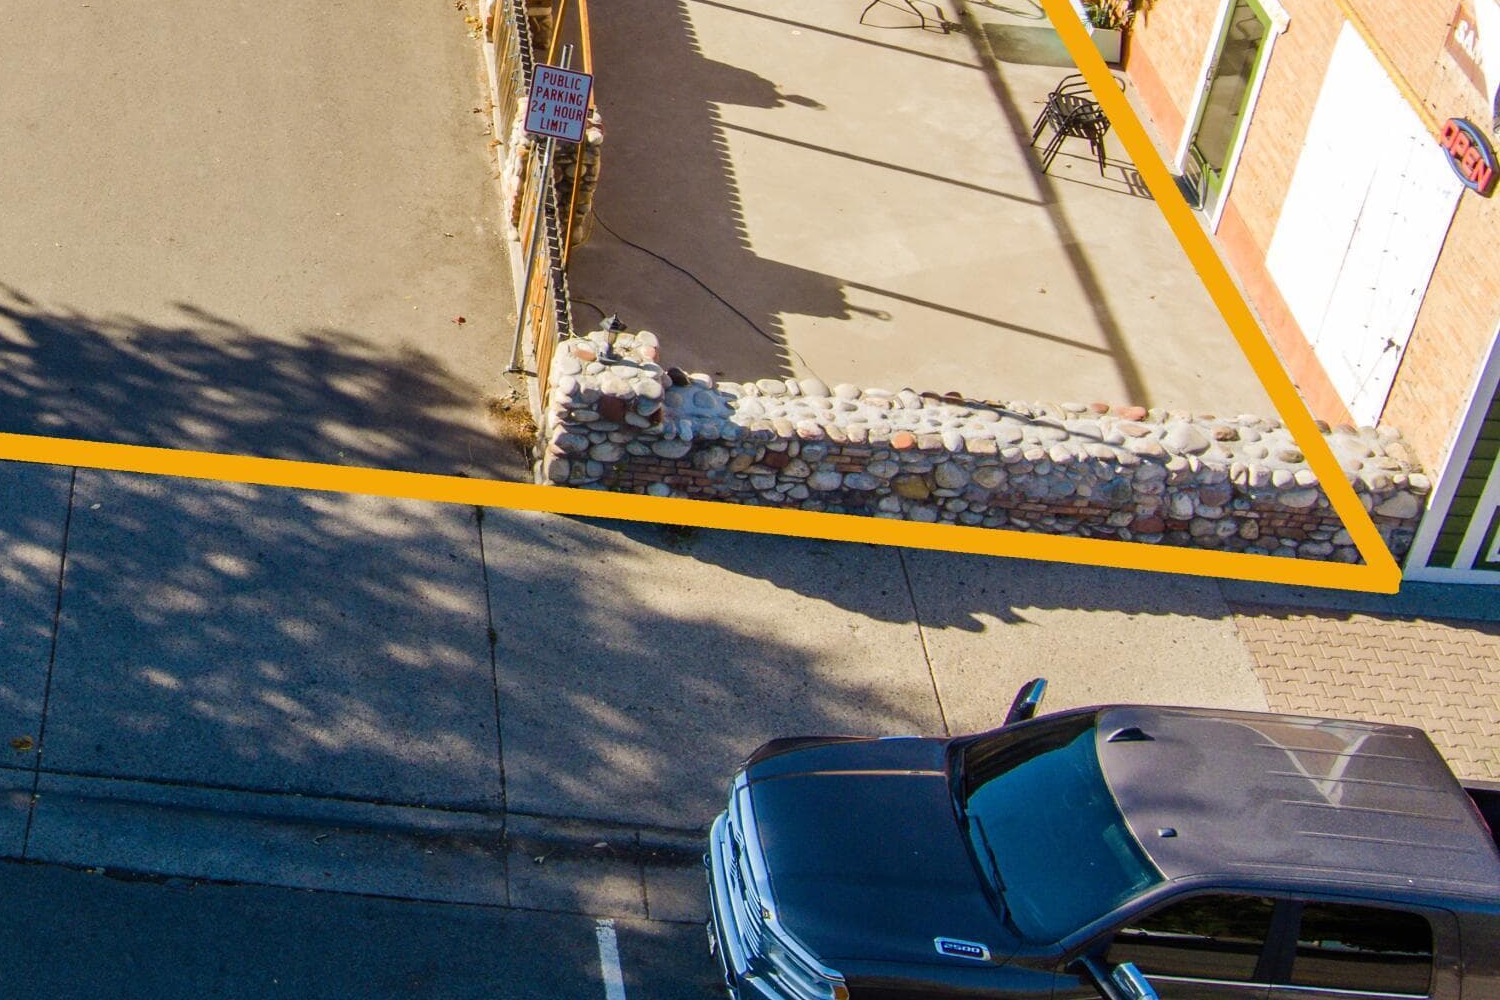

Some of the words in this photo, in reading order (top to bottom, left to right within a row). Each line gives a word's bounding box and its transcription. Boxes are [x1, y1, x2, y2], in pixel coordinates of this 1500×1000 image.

[542, 71, 582, 90] PUBLIC
[536, 86, 584, 107] PARKING
[531, 100, 546, 114] 24
[553, 104, 583, 122] HOUR
[540, 117, 569, 133] LIMIT
[1441, 119, 1492, 192] OPEN
[943, 943, 980, 953] 2500
